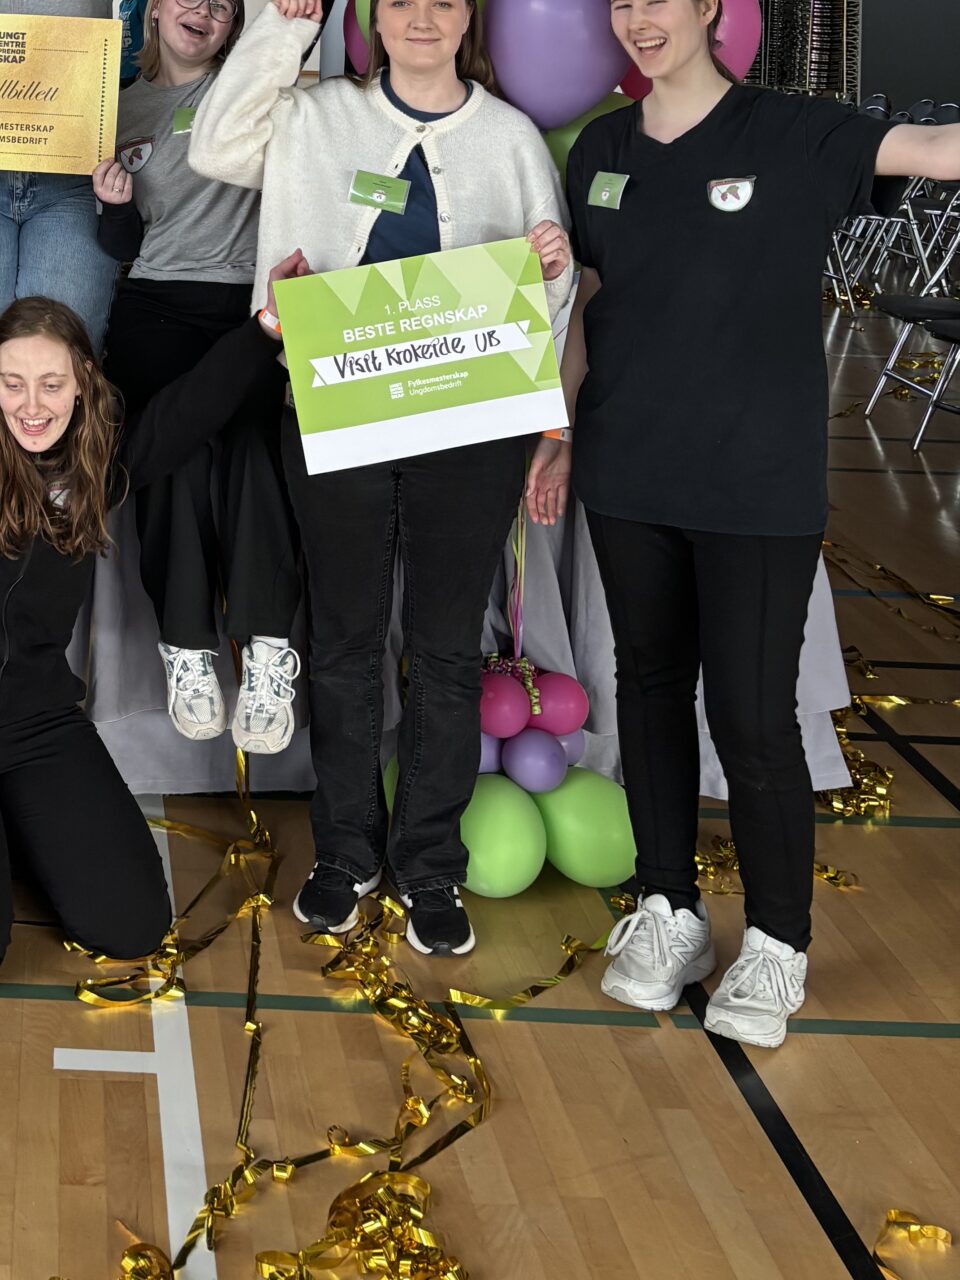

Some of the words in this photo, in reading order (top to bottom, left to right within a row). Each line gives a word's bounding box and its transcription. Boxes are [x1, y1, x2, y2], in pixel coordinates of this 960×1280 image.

[0, 32, 27, 41] UNGT
[385, 304, 395, 314] 1.
[399, 296, 441, 311] PLASS
[343, 322, 396, 343] BESTE
[400, 304, 488, 332] REGNSKAP
[334, 348, 381, 379] Visit
[386, 336, 466, 366] Krokeide
[475, 330, 501, 352] UB
[408, 371, 469, 387] Fylkesmesterskap
[409, 380, 462, 397] Ungdomsbedrift
